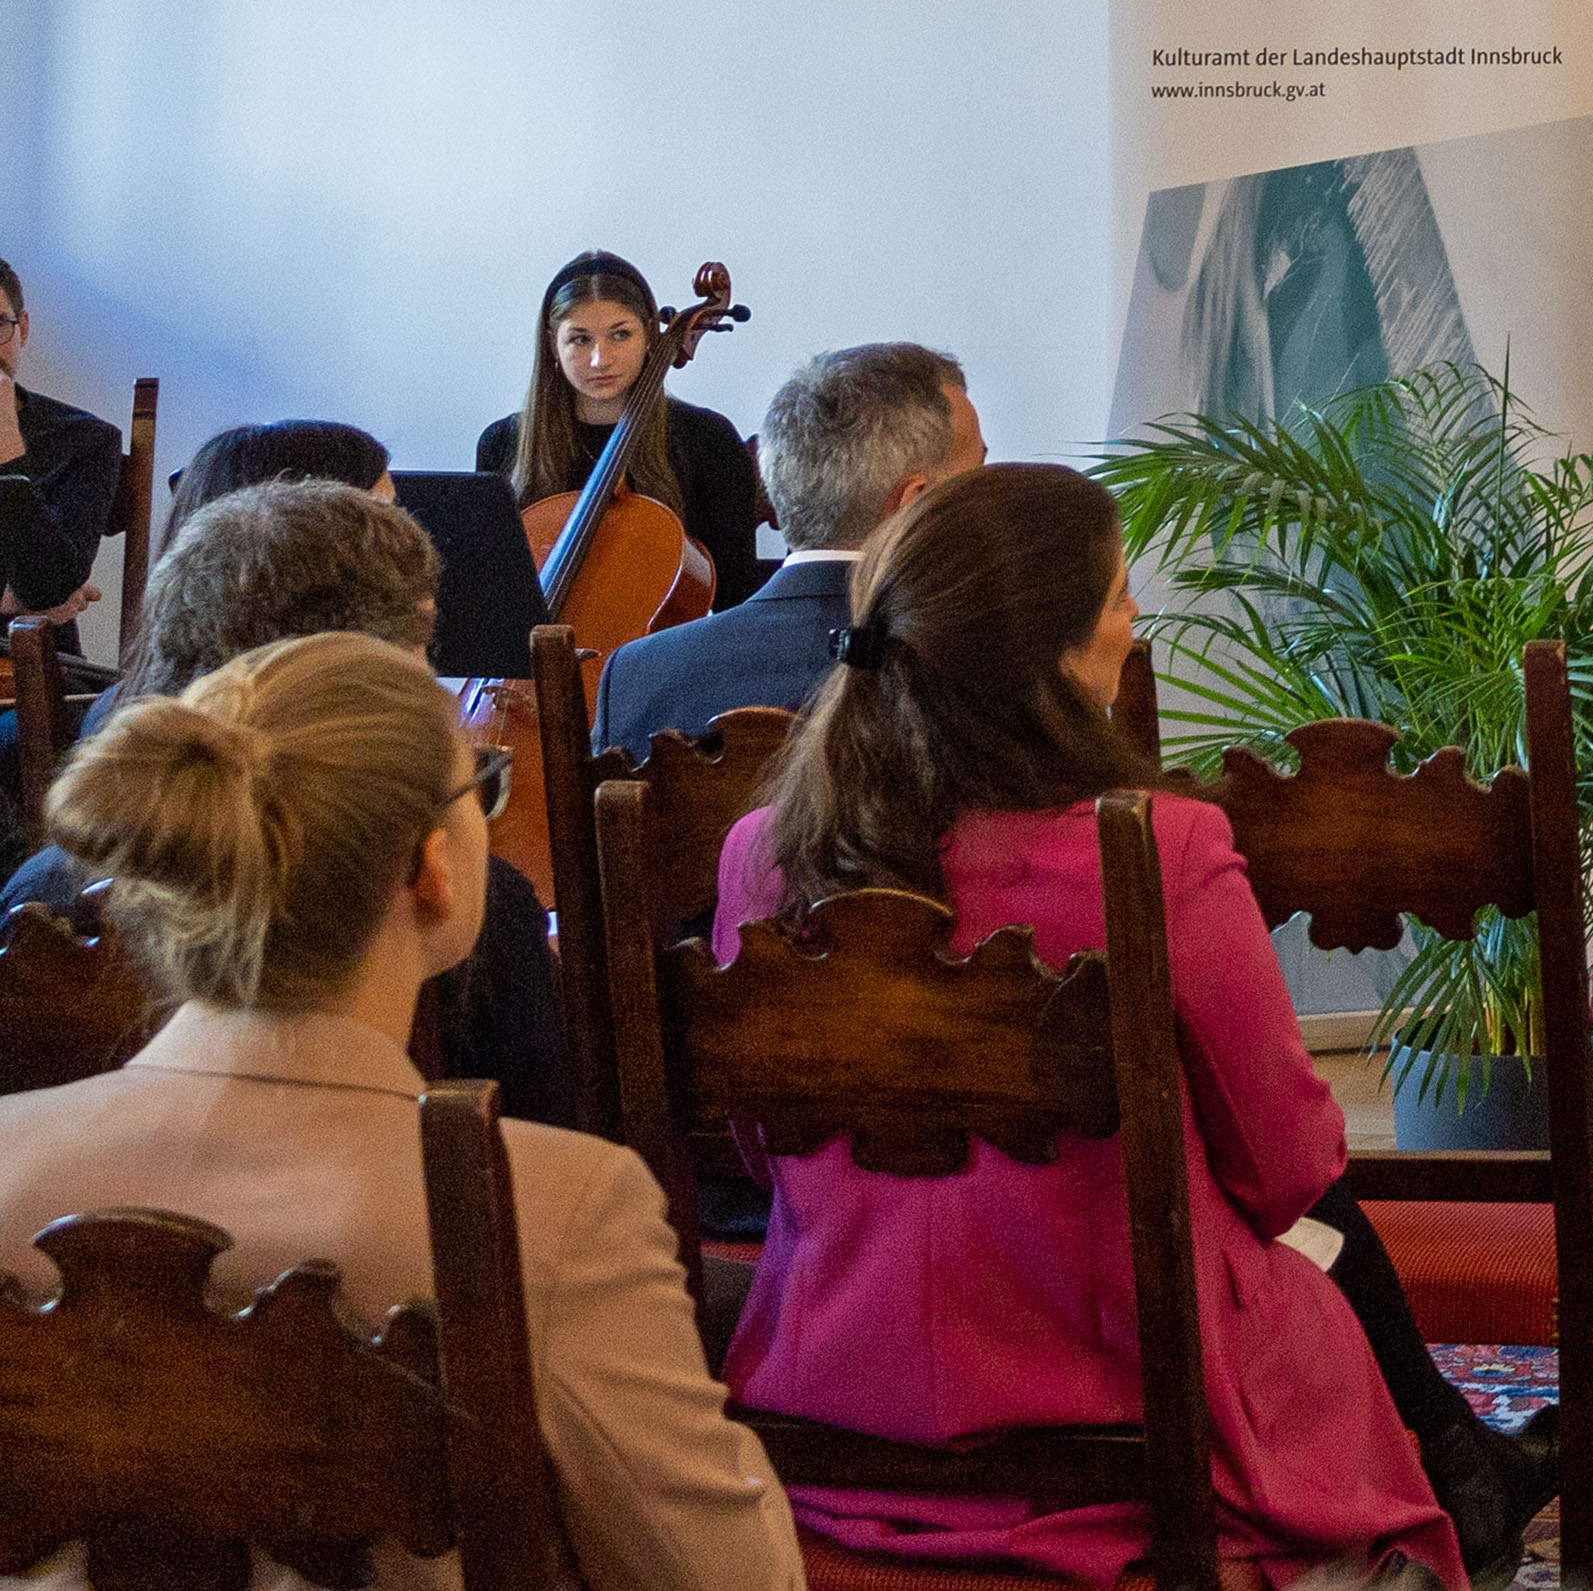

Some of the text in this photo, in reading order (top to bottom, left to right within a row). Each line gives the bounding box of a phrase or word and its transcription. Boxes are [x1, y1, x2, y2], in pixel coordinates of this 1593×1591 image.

[1152, 45, 1563, 71] Kulturamt der Landeshauptstadt Innsbruck
[1151, 80, 1326, 102] www.innsbruck.gv.at
